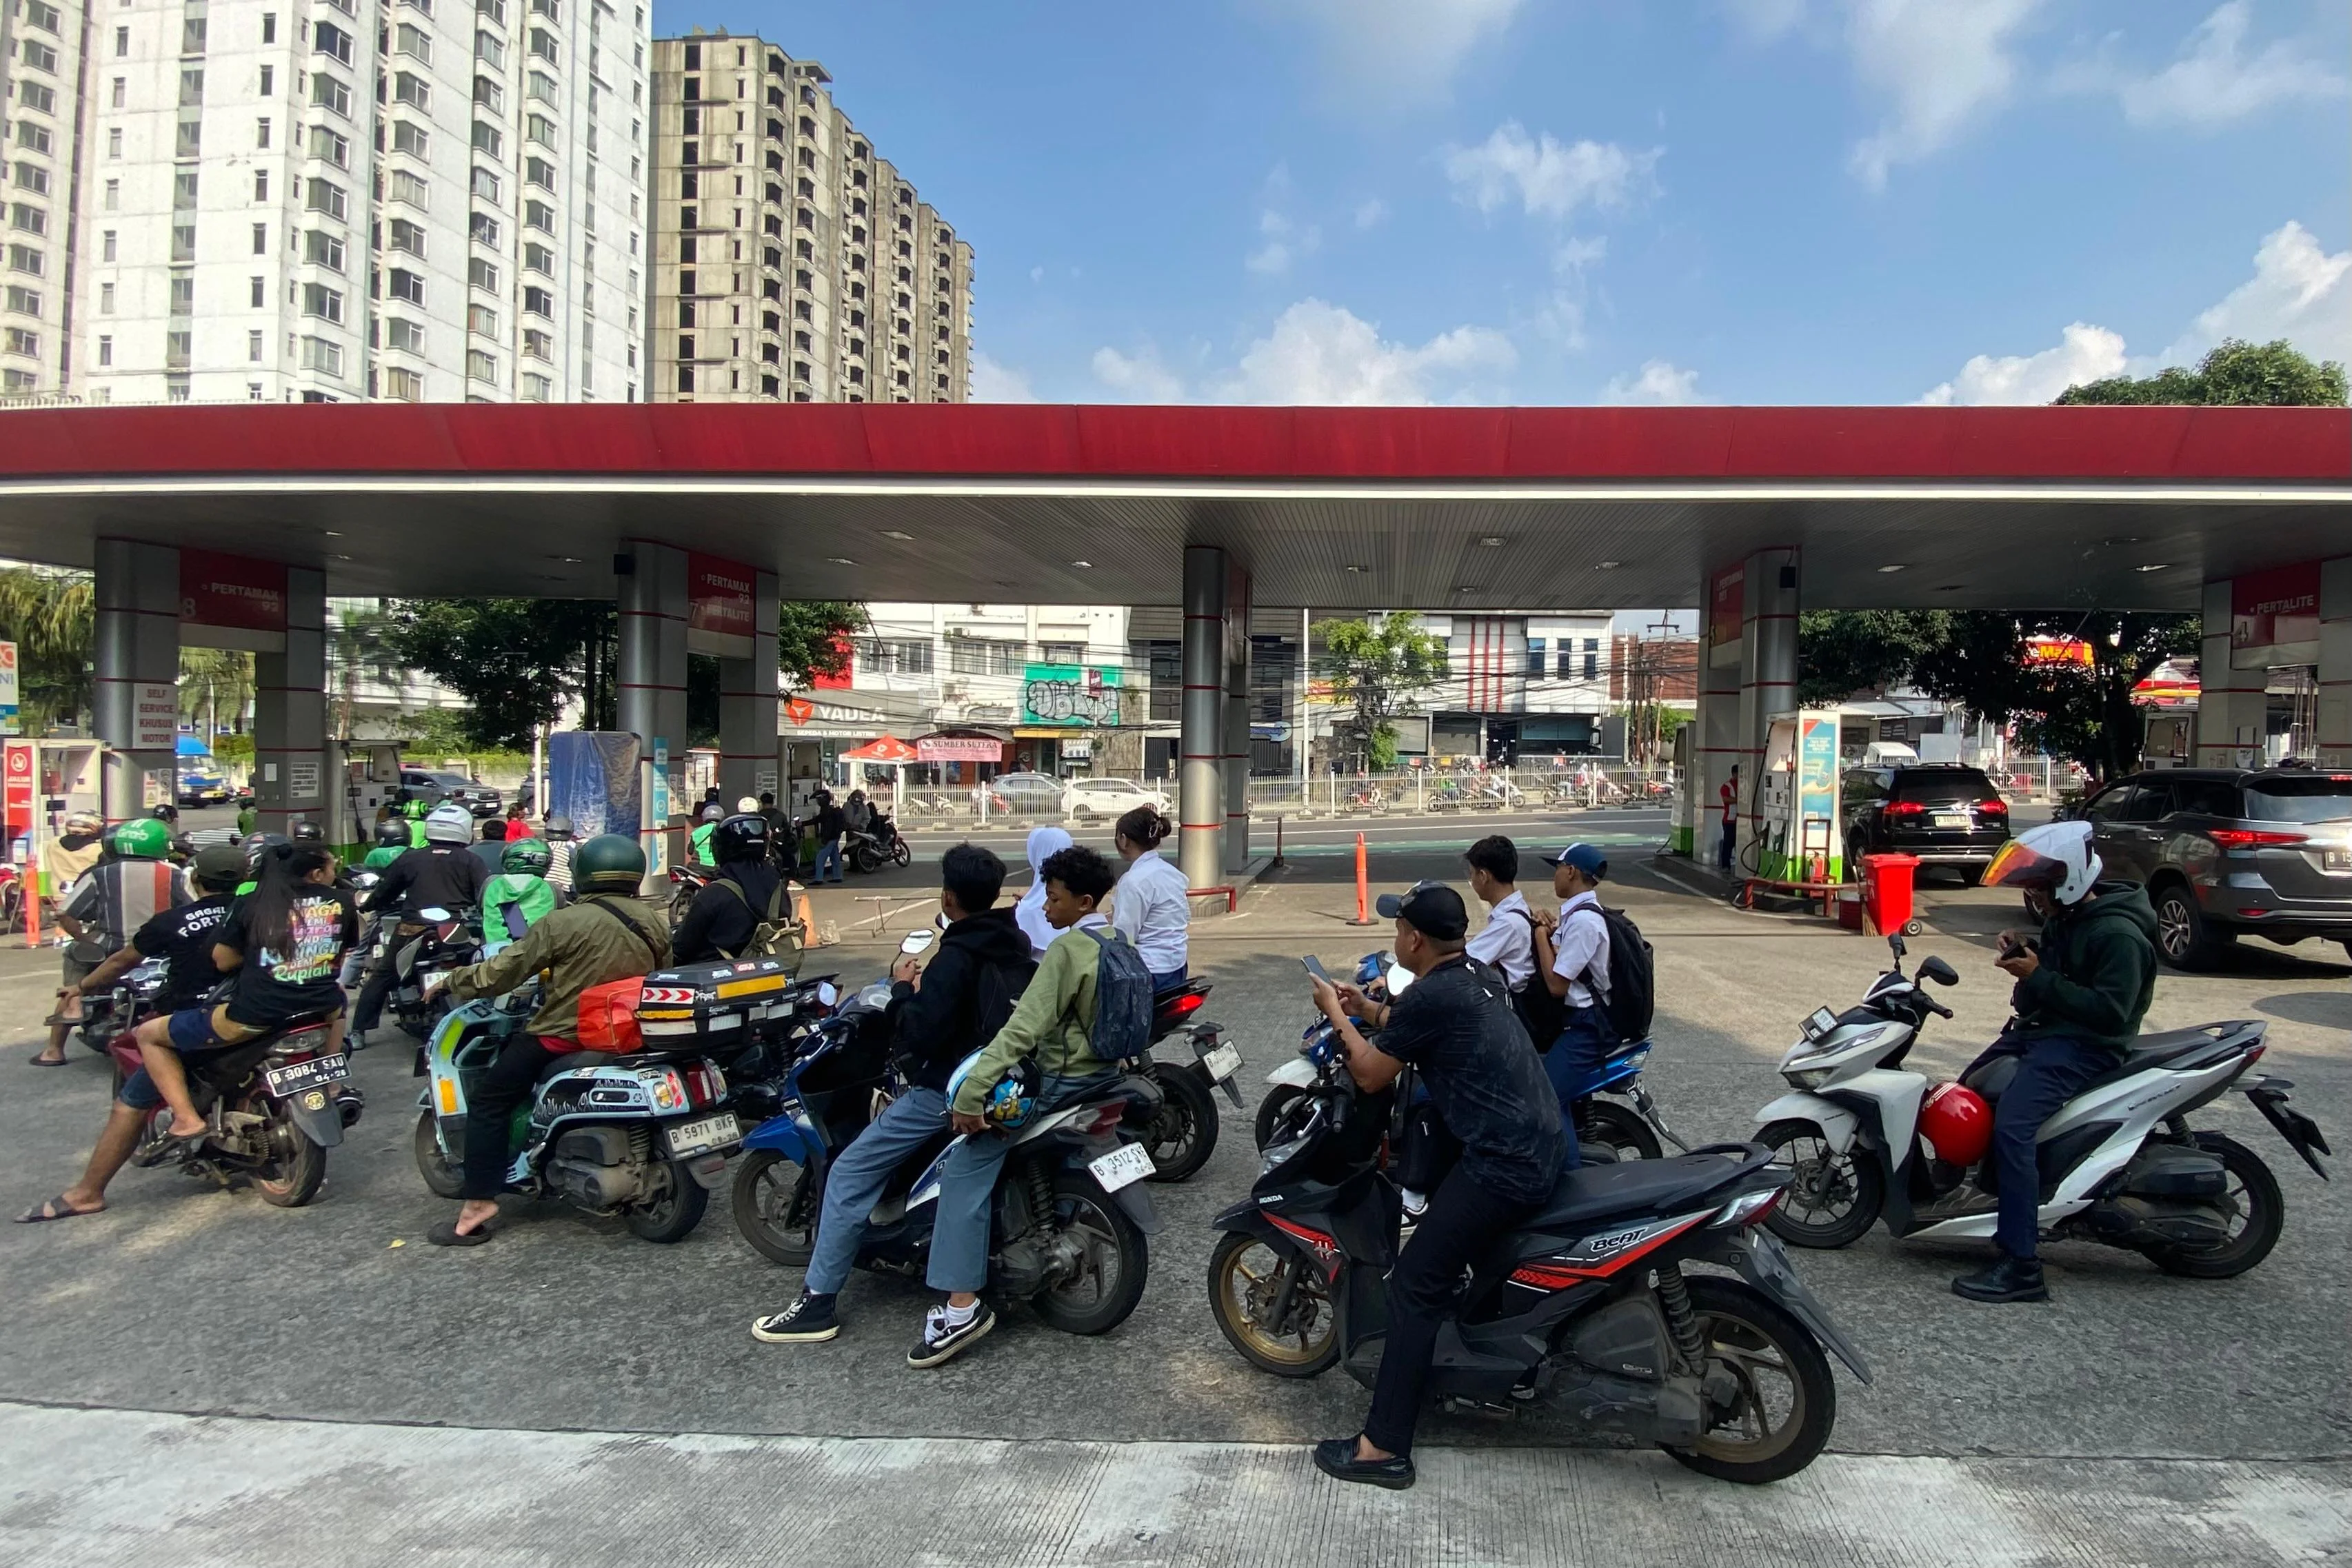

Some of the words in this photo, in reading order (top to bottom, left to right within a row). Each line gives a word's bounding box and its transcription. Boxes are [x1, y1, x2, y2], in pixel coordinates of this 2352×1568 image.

[707, 573, 750, 593] PERTAMAX
[211, 583, 279, 601] PERTAMAX
[2256, 594, 2314, 615] PERTALITE
[0, 673, 14, 685] NI
[147, 689, 167, 698] SELF
[139, 704, 175, 713] SERVICE
[818, 706, 886, 722] YADEA
[142, 734, 171, 743] MOTOR
[116, 828, 149, 841] Grab
[2328, 852, 2335, 863] B
[272, 961, 332, 985] Rupiah
[272, 1072, 282, 1085] B
[671, 1132, 679, 1143] B
[684, 1123, 710, 1139] 5971
[1094, 1165, 1105, 1176] B
[1108, 1152, 1132, 1169] 3512
[1258, 1194, 1283, 1204] HONDA
